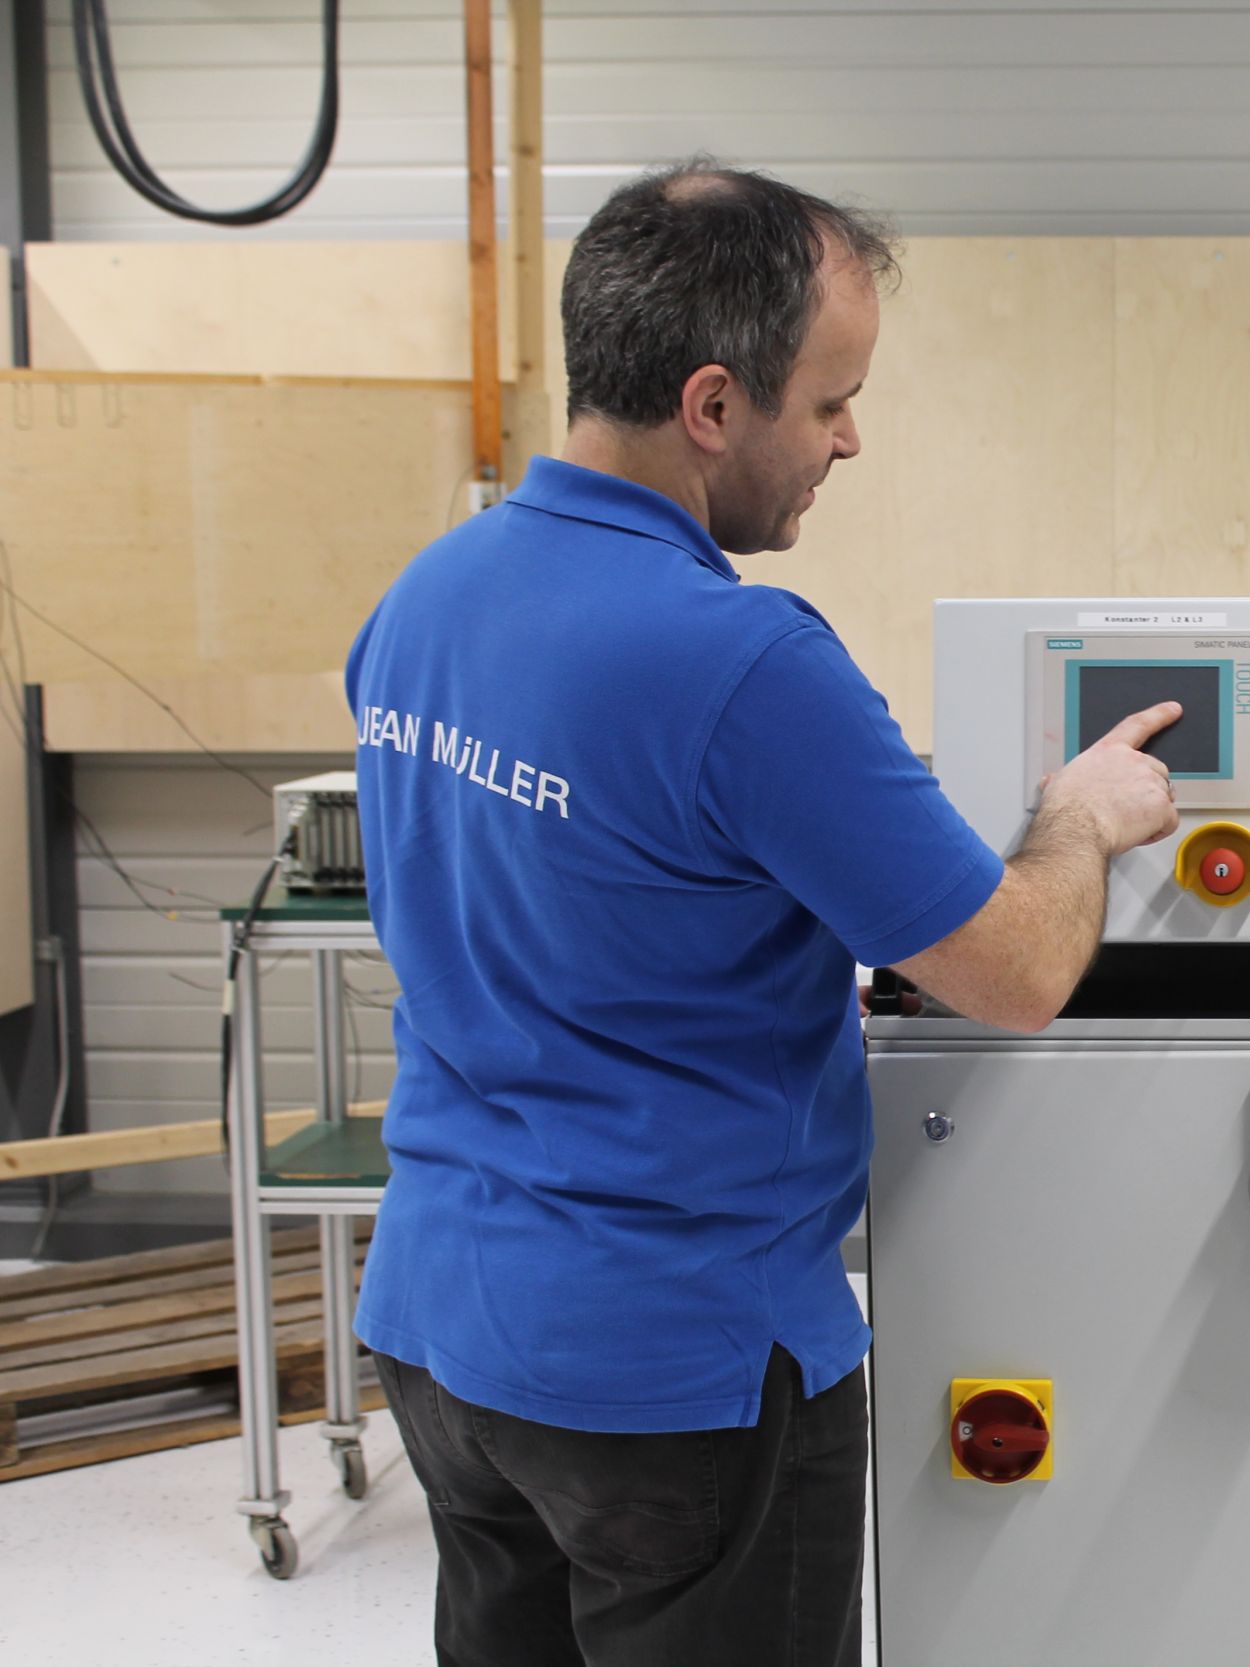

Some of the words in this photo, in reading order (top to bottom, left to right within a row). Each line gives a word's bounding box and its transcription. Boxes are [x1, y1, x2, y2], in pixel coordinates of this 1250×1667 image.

[1048, 640, 1082, 649] SIEMENS
[1193, 640, 1226, 649] SIMATIC
[358, 705, 421, 757] JEAN
